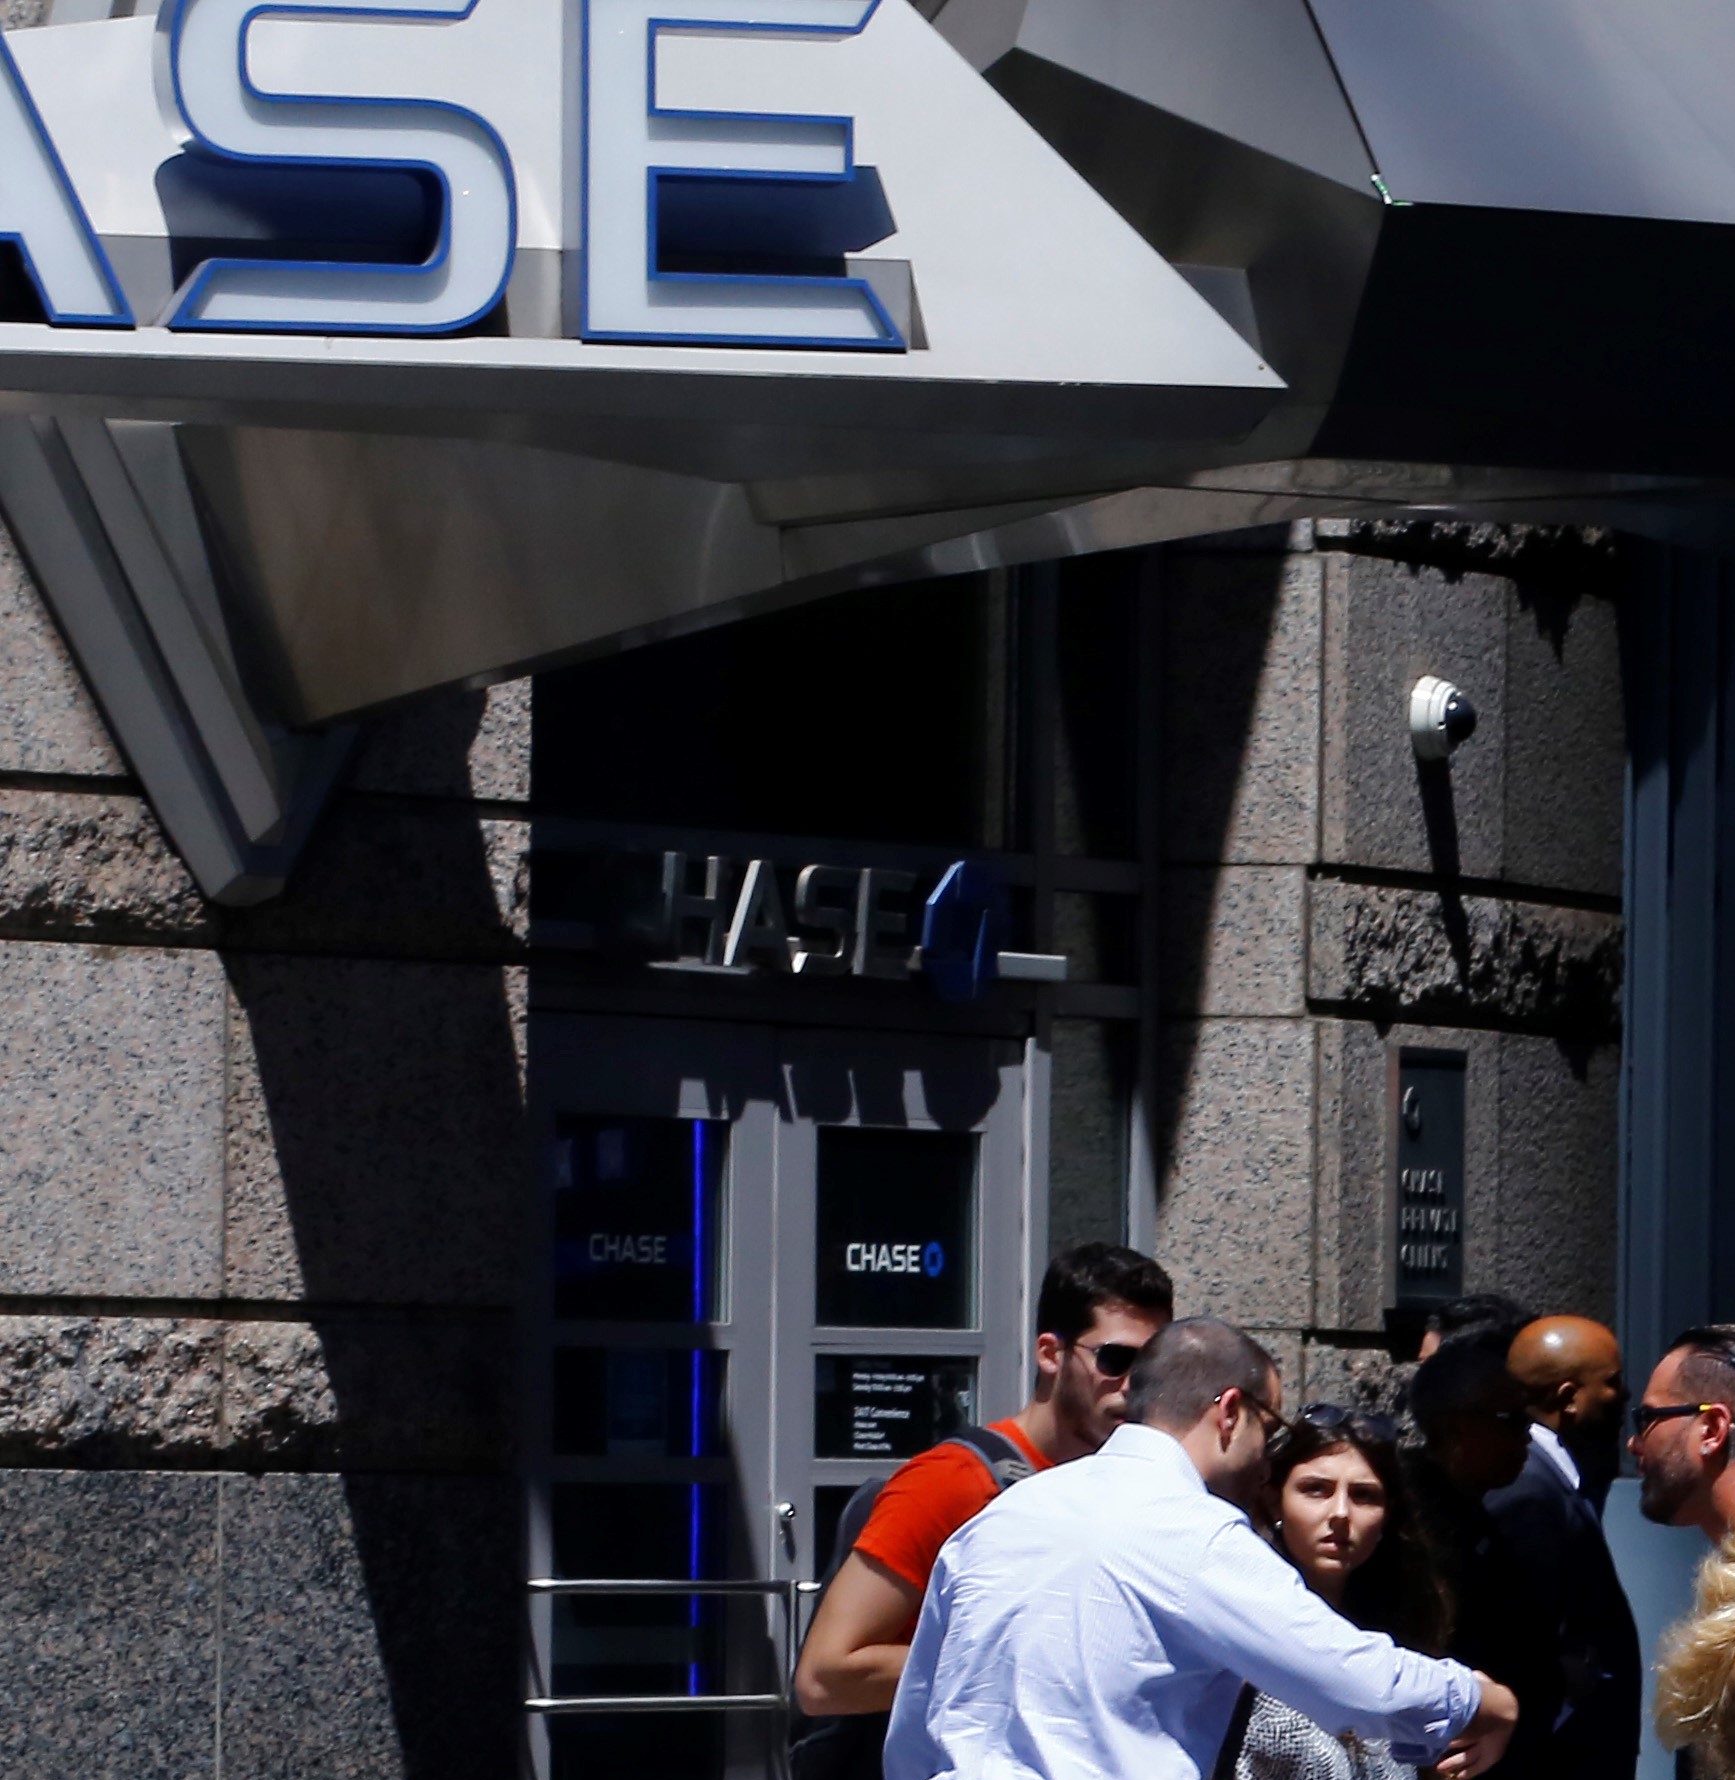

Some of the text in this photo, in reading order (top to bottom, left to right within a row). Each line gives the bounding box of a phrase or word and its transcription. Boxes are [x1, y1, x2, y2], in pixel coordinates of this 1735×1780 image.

[632, 850, 917, 978] HASE
[588, 1232, 668, 1264] CHASE
[845, 1242, 922, 1273] CHASE
